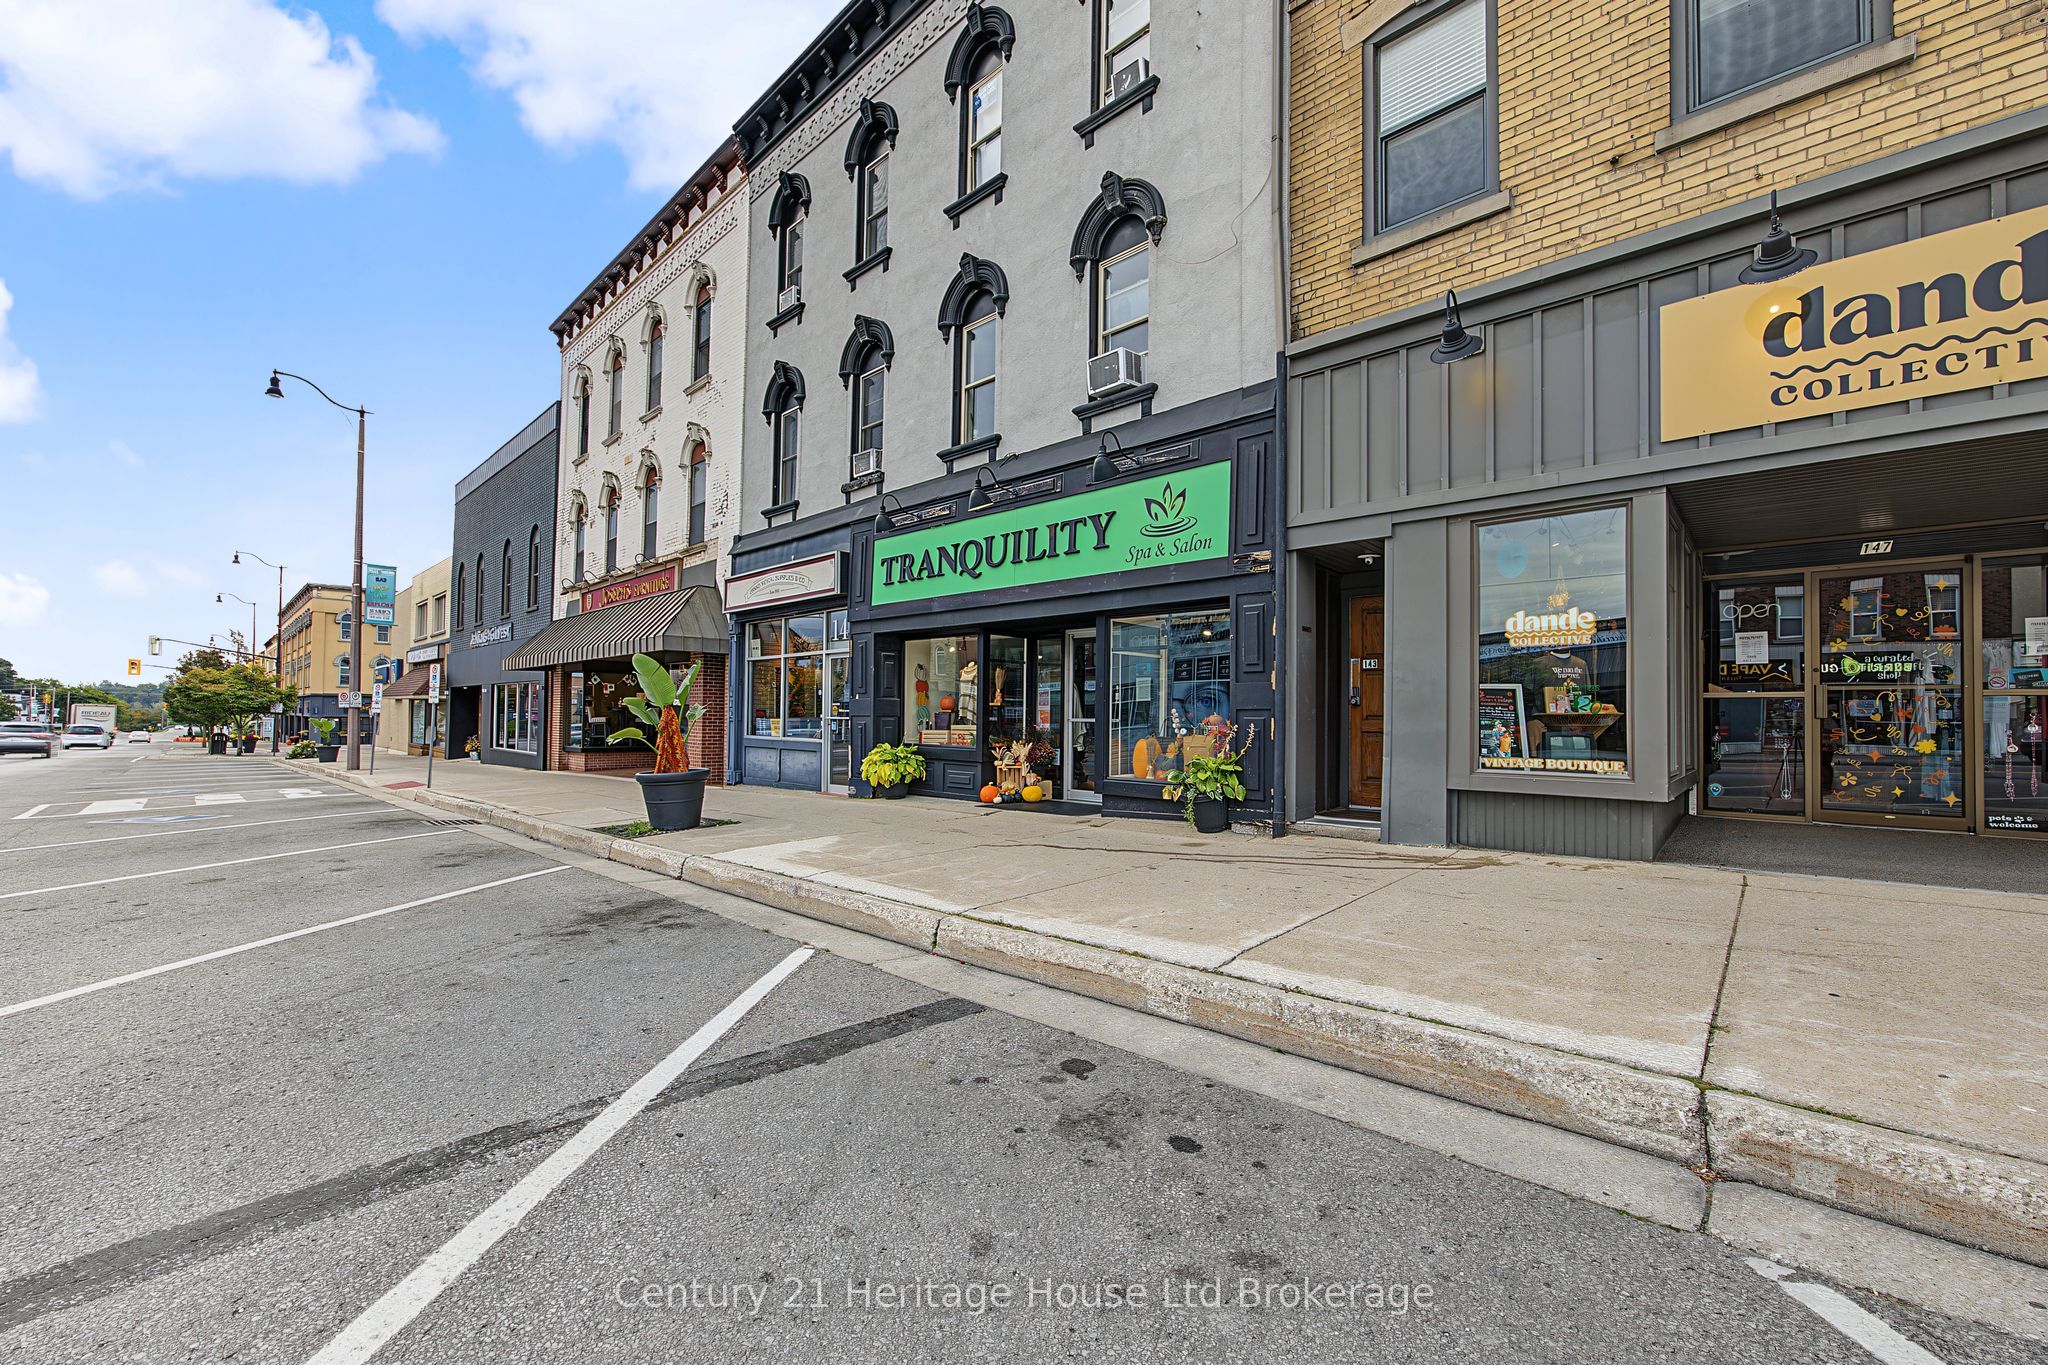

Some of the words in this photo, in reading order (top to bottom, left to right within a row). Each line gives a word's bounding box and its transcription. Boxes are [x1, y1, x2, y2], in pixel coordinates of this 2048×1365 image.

[1770, 335, 2048, 406] COLLECTI
[880, 510, 1117, 586] TRANQUILITY
[1125, 545, 1151, 566] Spa
[1155, 543, 1166, 557] &
[1170, 532, 1212, 557] Salon
[1864, 542, 1891, 553] 147
[1506, 607, 1596, 633] dande
[1723, 603, 1781, 629] open
[1510, 636, 1592, 648] COLLECTIVE
[1364, 660, 1377, 668] 143
[1873, 653, 1914, 663] curated
[1877, 671, 1901, 680] shop
[1482, 757, 1545, 769] VINTAGE
[1546, 759, 1625, 773] BOUTIQUE
[1988, 815, 2012, 823] pets
[1989, 821, 2039, 829] welcome
